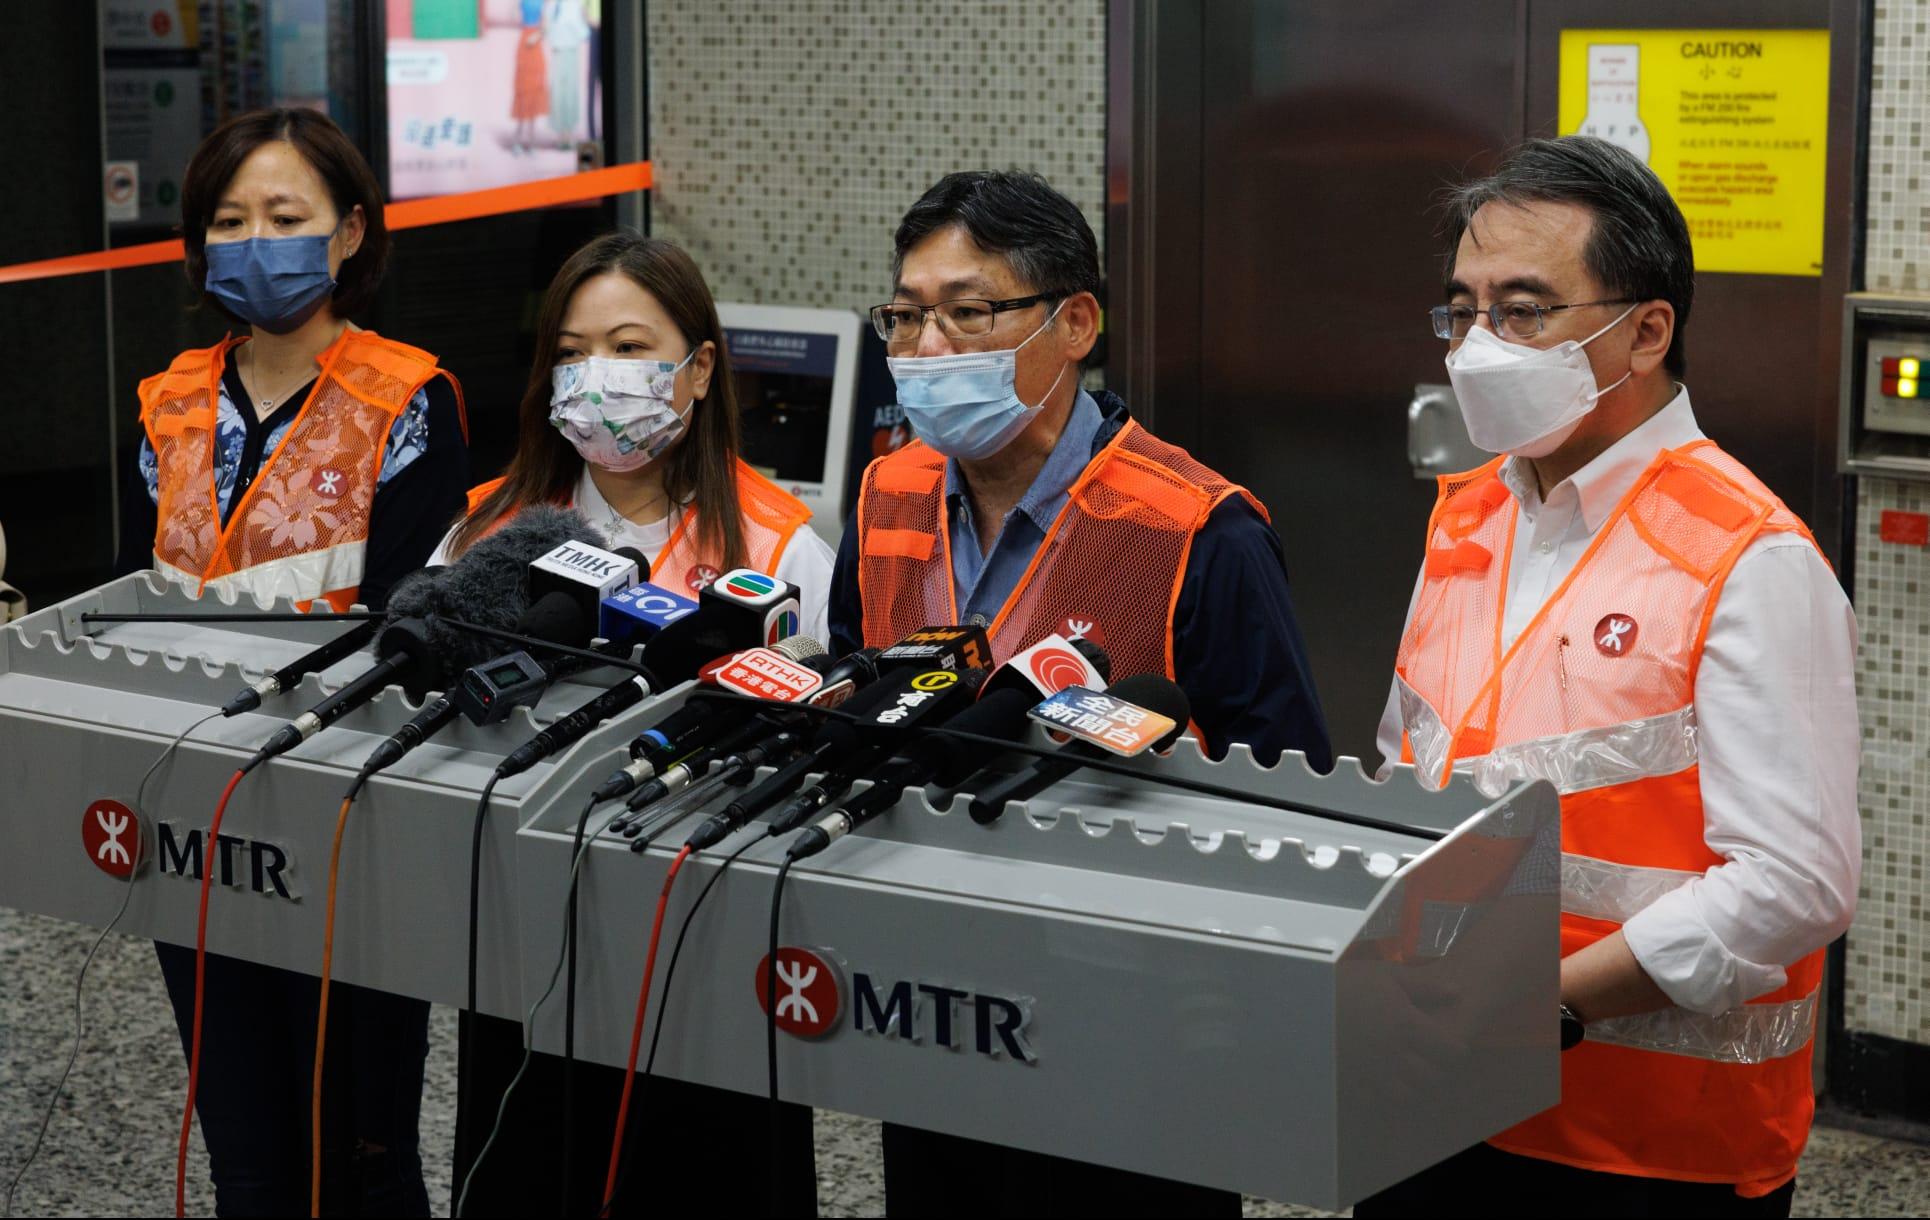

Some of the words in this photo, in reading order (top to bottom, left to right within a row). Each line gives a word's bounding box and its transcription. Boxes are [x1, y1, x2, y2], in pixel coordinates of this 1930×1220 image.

[1680, 41, 1762, 58] CAUTION
[1679, 90, 1699, 100] This
[1702, 91, 1721, 100] area
[1724, 91, 1731, 100] is
[1733, 91, 1777, 102] protected
[873, 405, 906, 427] AED
[554, 545, 622, 576] TMHK
[728, 667, 792, 700] 香港電台
[748, 655, 811, 688] RTHK
[1039, 702, 1141, 747] 新聞台
[1076, 695, 1147, 727] 全民
[158, 821, 296, 901] MTR
[852, 971, 1031, 1063] MTR
